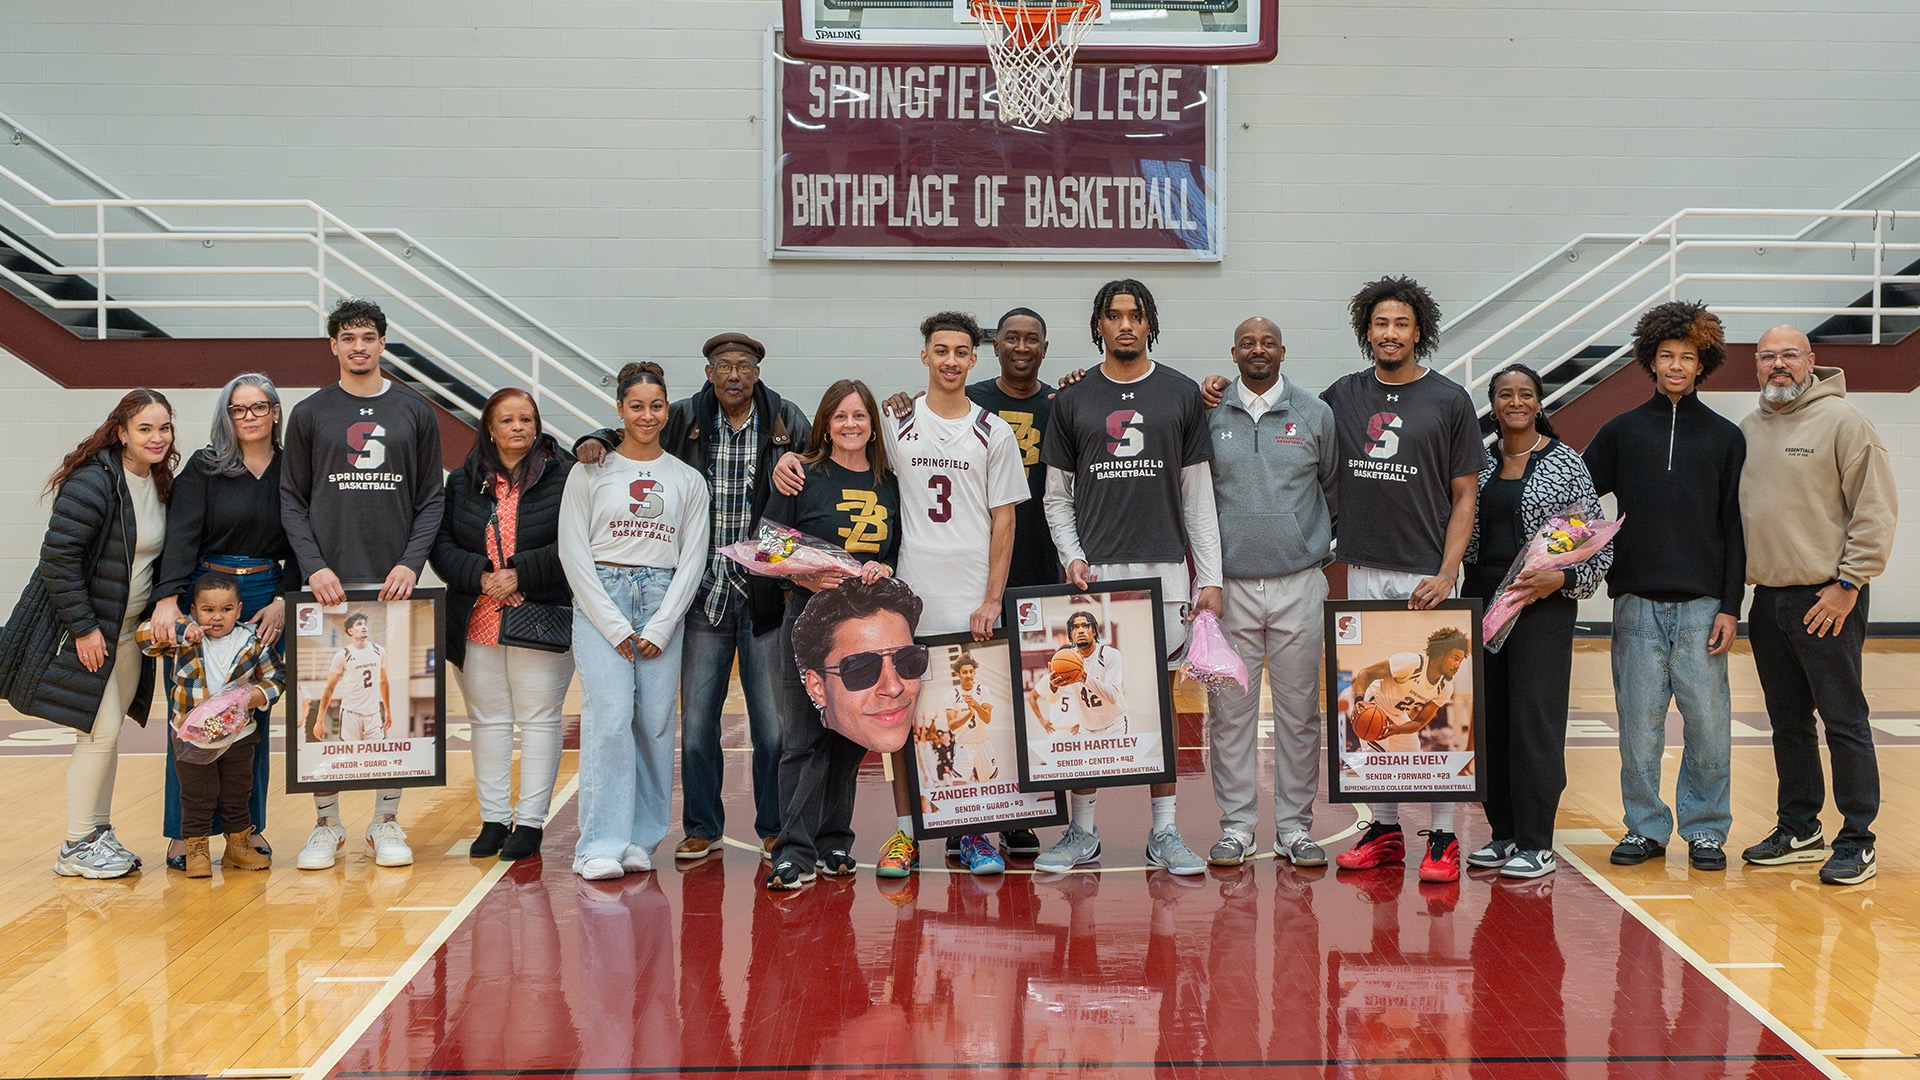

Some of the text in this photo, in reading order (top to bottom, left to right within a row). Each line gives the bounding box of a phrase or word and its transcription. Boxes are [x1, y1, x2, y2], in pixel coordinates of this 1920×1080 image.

[815, 30, 861, 40] SPALDING
[791, 173, 1197, 230] BIRTHPLACE OF BASKETBALL
[911, 457, 970, 470] SPRINGFIELD
[1089, 459, 1164, 473] SPRINGFIELD
[1348, 459, 1418, 475] SPRINGFIELD
[328, 472, 403, 483] SPRINGFIELD
[1097, 469, 1156, 480] BASKETBALL
[1353, 469, 1408, 482] BASKETBALL
[338, 481, 396, 491] BASKETBALL
[927, 474, 952, 523] 3
[609, 520, 676, 535] SPRINGFIELD
[612, 529, 672, 544] BASKETBALL
[362, 669, 373, 688] 2
[1061, 696, 1070, 713] 5
[322, 741, 411, 755] JOHN PAULINO
[1050, 736, 1138, 754] JOSH HARTLEY
[331, 758, 403, 769] SENIOR GUARD #2
[1056, 755, 1134, 768] SENIOR CENTER #42
[1364, 754, 1449, 767] JOSIAH EVELY
[301, 773, 344, 782] SPRGFIELD
[372, 770, 392, 778] MEN'S
[392, 769, 432, 777] BASKETBALL
[1032, 765, 1160, 781] SPRINGFIELD COLLEGE MEN'S BASKETBALL
[1365, 772, 1451, 781] SENIOR FORWARD #23
[930, 787, 978, 801] ZANDER
[954, 805, 981, 814] SENIOR
[986, 801, 1010, 810] GUARD
[927, 808, 1054, 828] SPRINGFIELD COLLEGE MEN'S BASKETBALL
